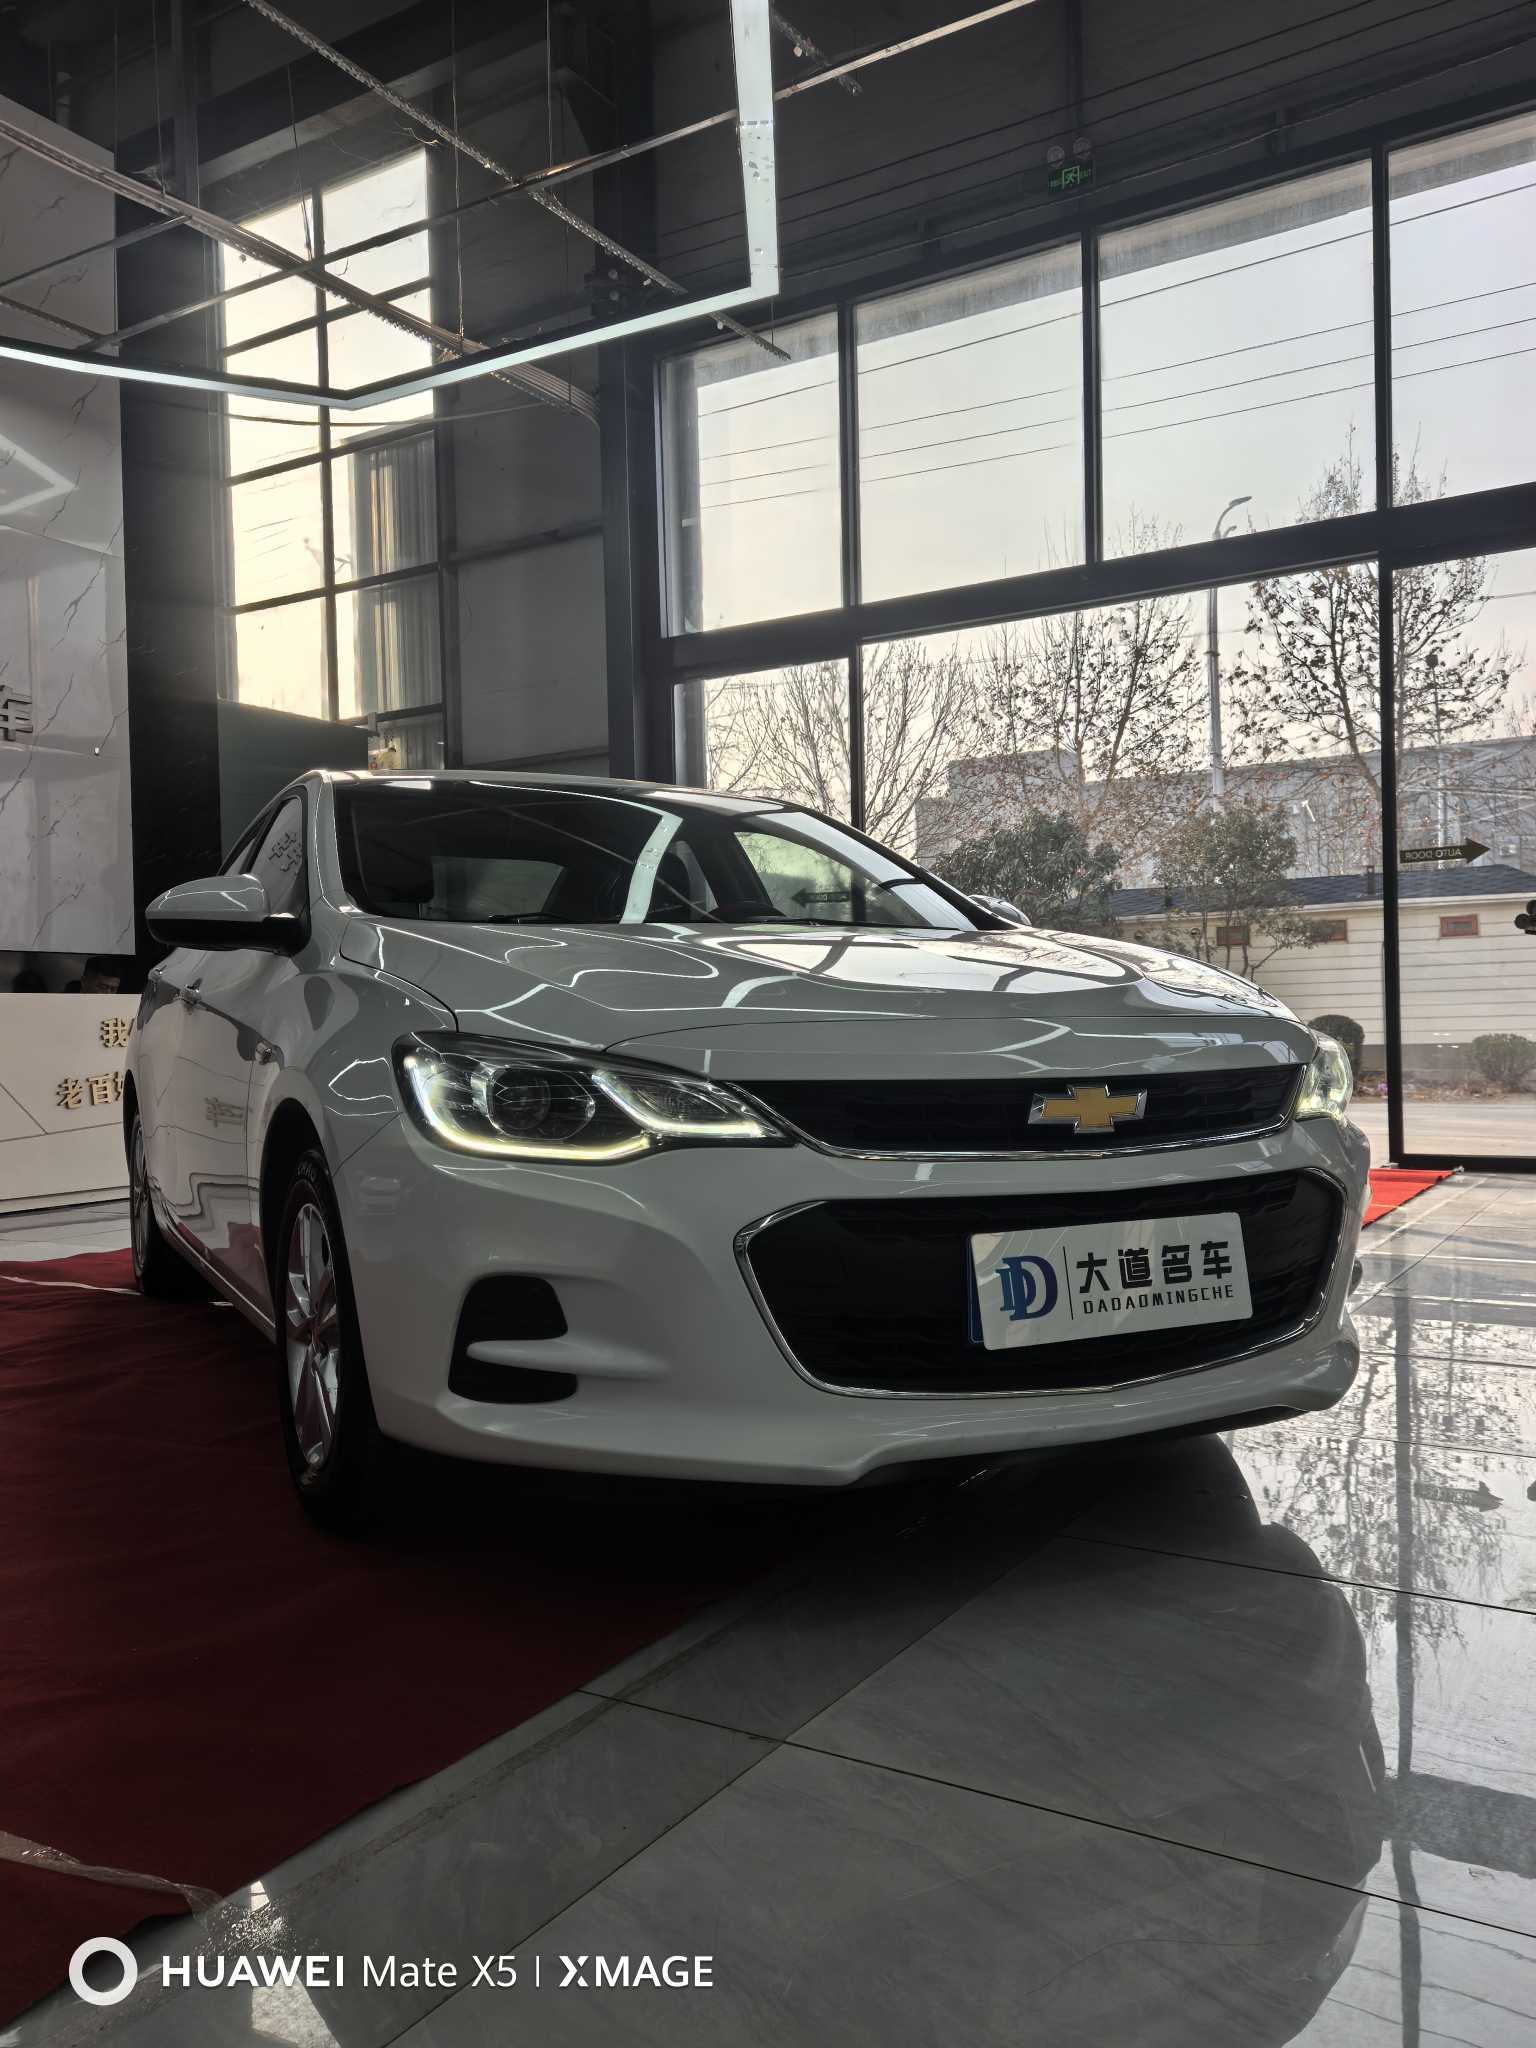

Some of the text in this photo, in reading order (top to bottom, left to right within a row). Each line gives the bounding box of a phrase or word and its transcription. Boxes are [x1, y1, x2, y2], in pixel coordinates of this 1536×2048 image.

[100, 1017, 134, 1048] 我
[1076, 1240, 1233, 1294] 大道名车
[1083, 1284, 1235, 1314] DADAOMINGCHE
